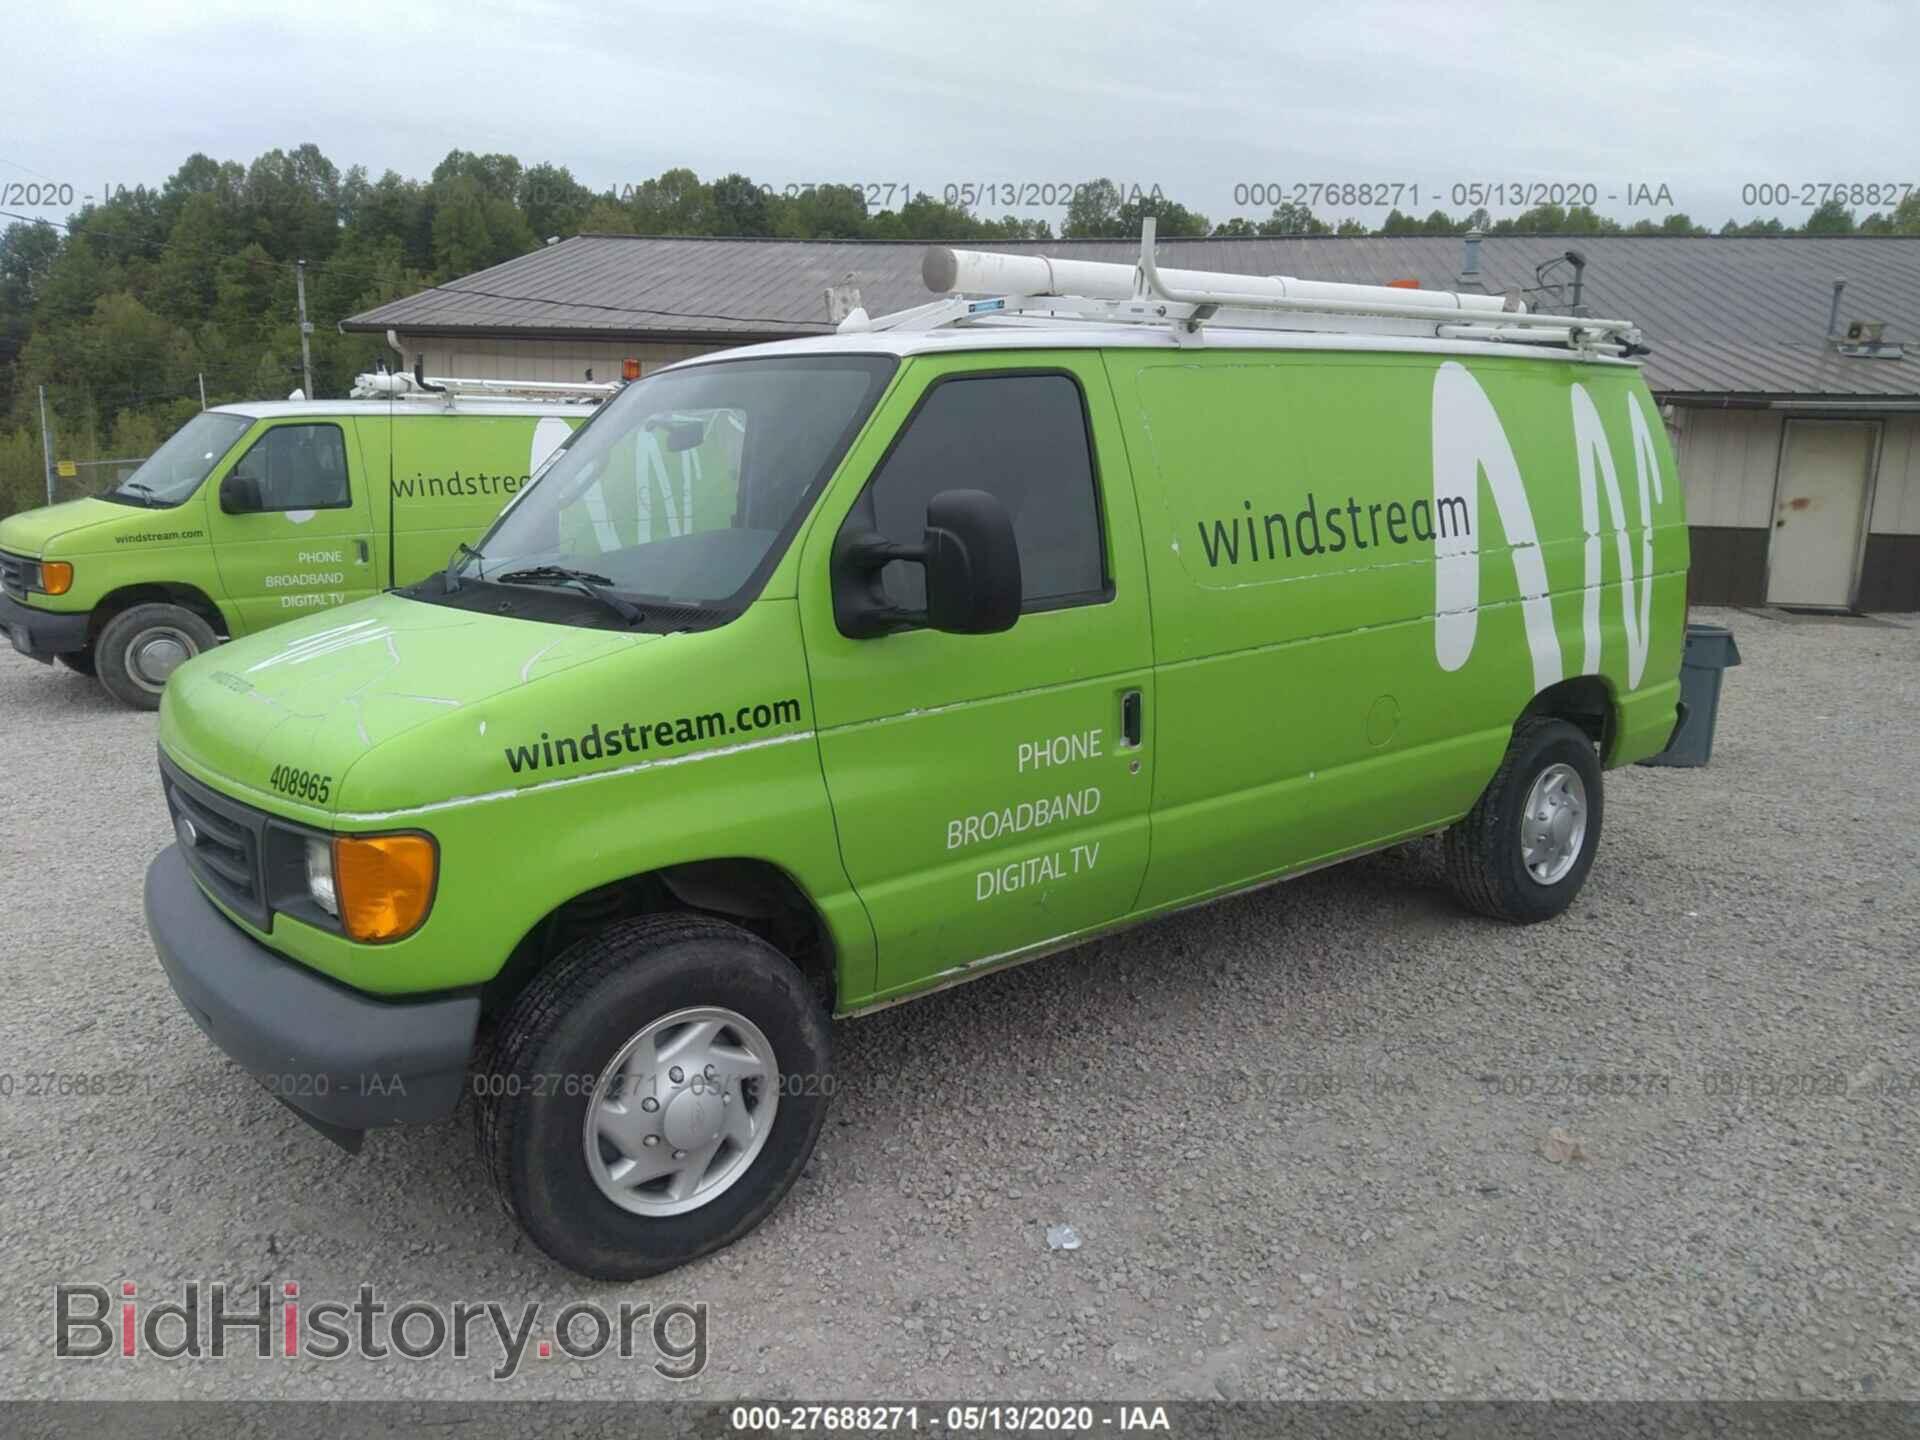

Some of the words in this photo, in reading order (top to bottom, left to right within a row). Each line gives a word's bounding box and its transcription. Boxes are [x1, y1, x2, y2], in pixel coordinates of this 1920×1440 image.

[114, 528, 204, 544] windstream.com
[1198, 493, 1471, 567] windstream
[298, 550, 344, 563] PHONE
[265, 572, 344, 588] BROADBAND
[281, 594, 328, 608] DIGITAL
[328, 591, 345, 605] TV
[505, 698, 801, 773] windstream.com
[1018, 729, 1103, 773] PHONE
[270, 763, 332, 804] 408965
[947, 787, 1101, 849] BROADBAND
[976, 852, 1067, 901] DIGITAL
[1070, 842, 1100, 869] TV
